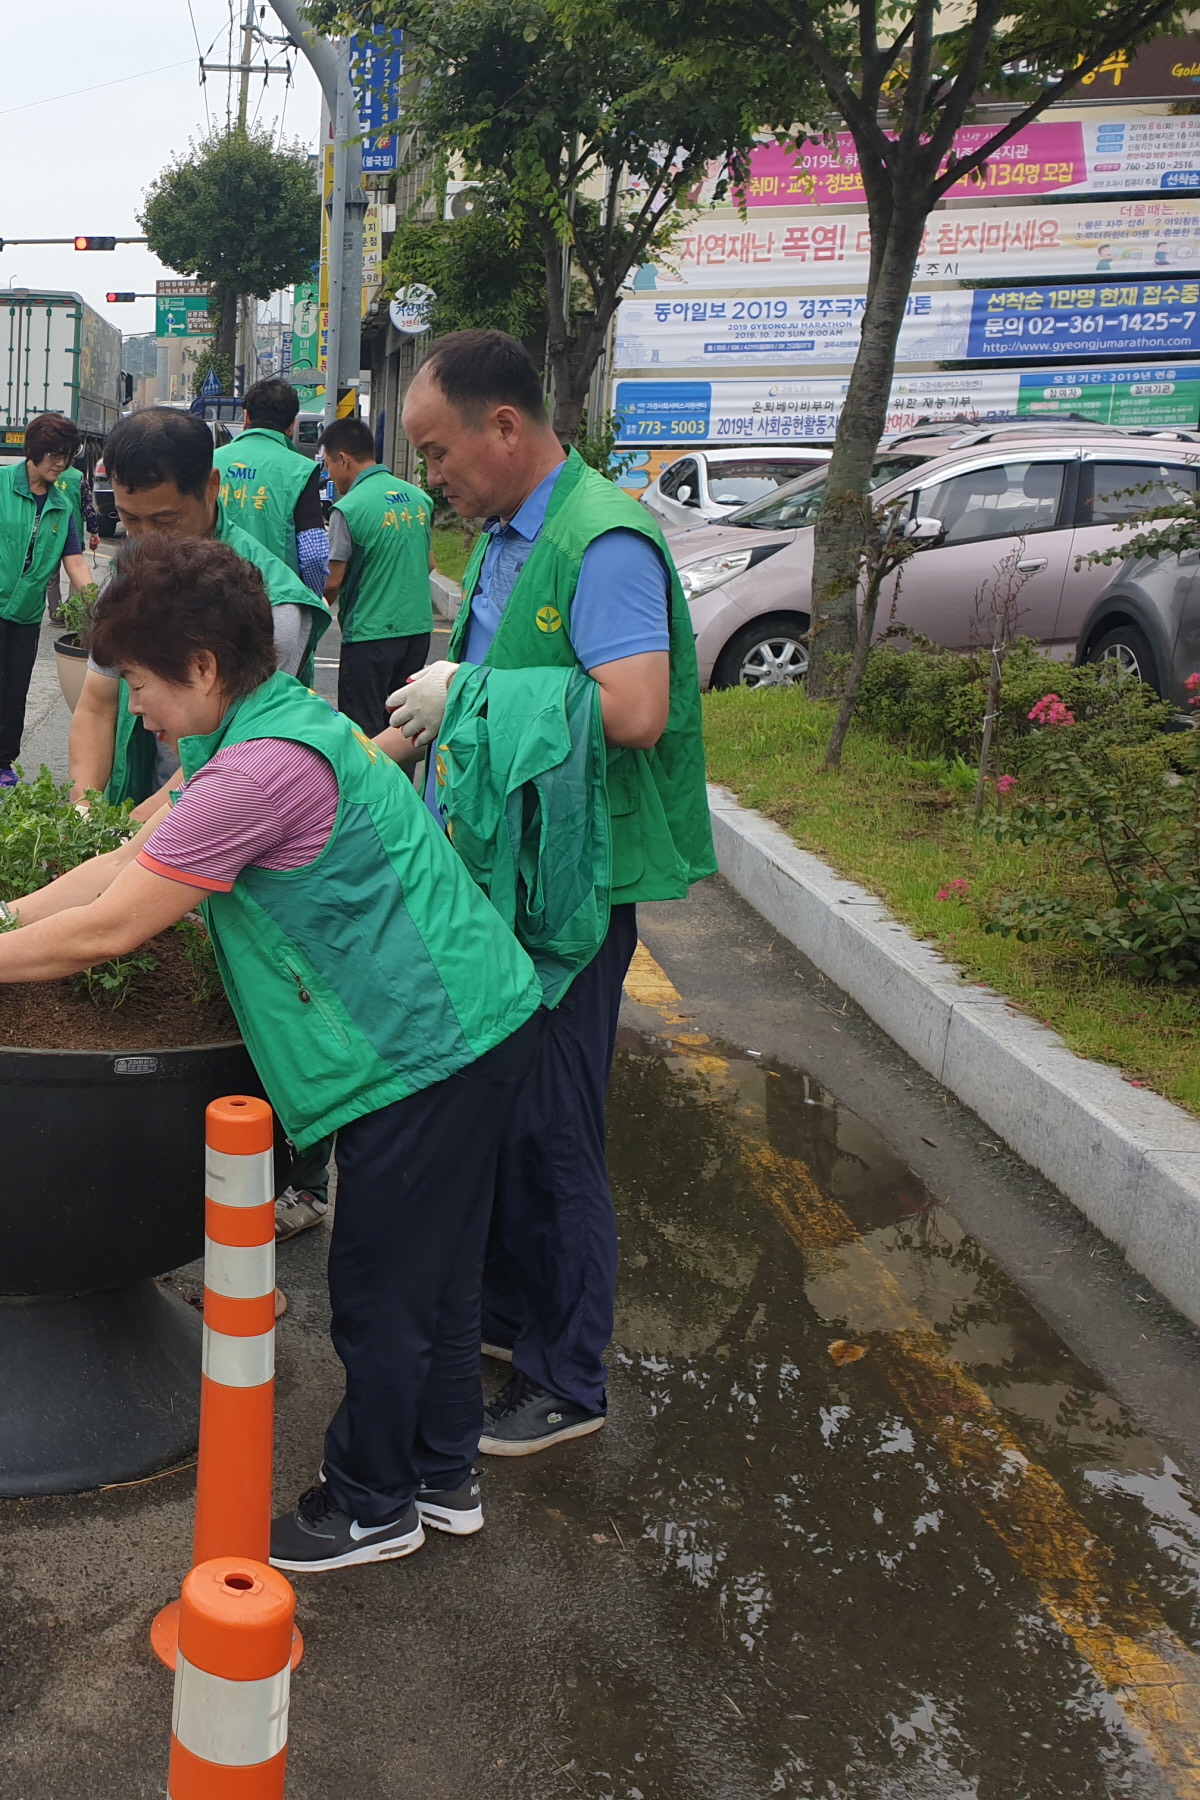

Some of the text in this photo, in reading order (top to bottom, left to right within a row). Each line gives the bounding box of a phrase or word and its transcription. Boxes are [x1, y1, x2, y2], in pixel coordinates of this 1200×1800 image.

[362, 155, 393, 167] (불국점)
[1043, 162, 1074, 183] 모집
[1166, 173, 1200, 186] 선착순
[679, 231, 775, 266] 자연재난
[781, 224, 847, 263] 폭염!
[936, 219, 1061, 256] 참지마세요
[987, 283, 1199, 312] 선착순 1만명 현재 접수중
[654, 302, 727, 323] 동아일보
[731, 301, 788, 320] 2019
[800, 321, 853, 329] MARATHON
[984, 317, 1024, 338] 문의
[774, 330, 785, 338] 20
[787, 330, 806, 338] SUN
[982, 336, 1192, 353] http://www.gyeongjumarathon.com
[1109, 371, 1151, 381] 2019년
[894, 396, 972, 409] 위한 재능기부
[717, 416, 754, 436] 2019년
[226, 466, 257, 480] SMU
[385, 493, 411, 504] SMU
[382, 505, 427, 531] 새마을
